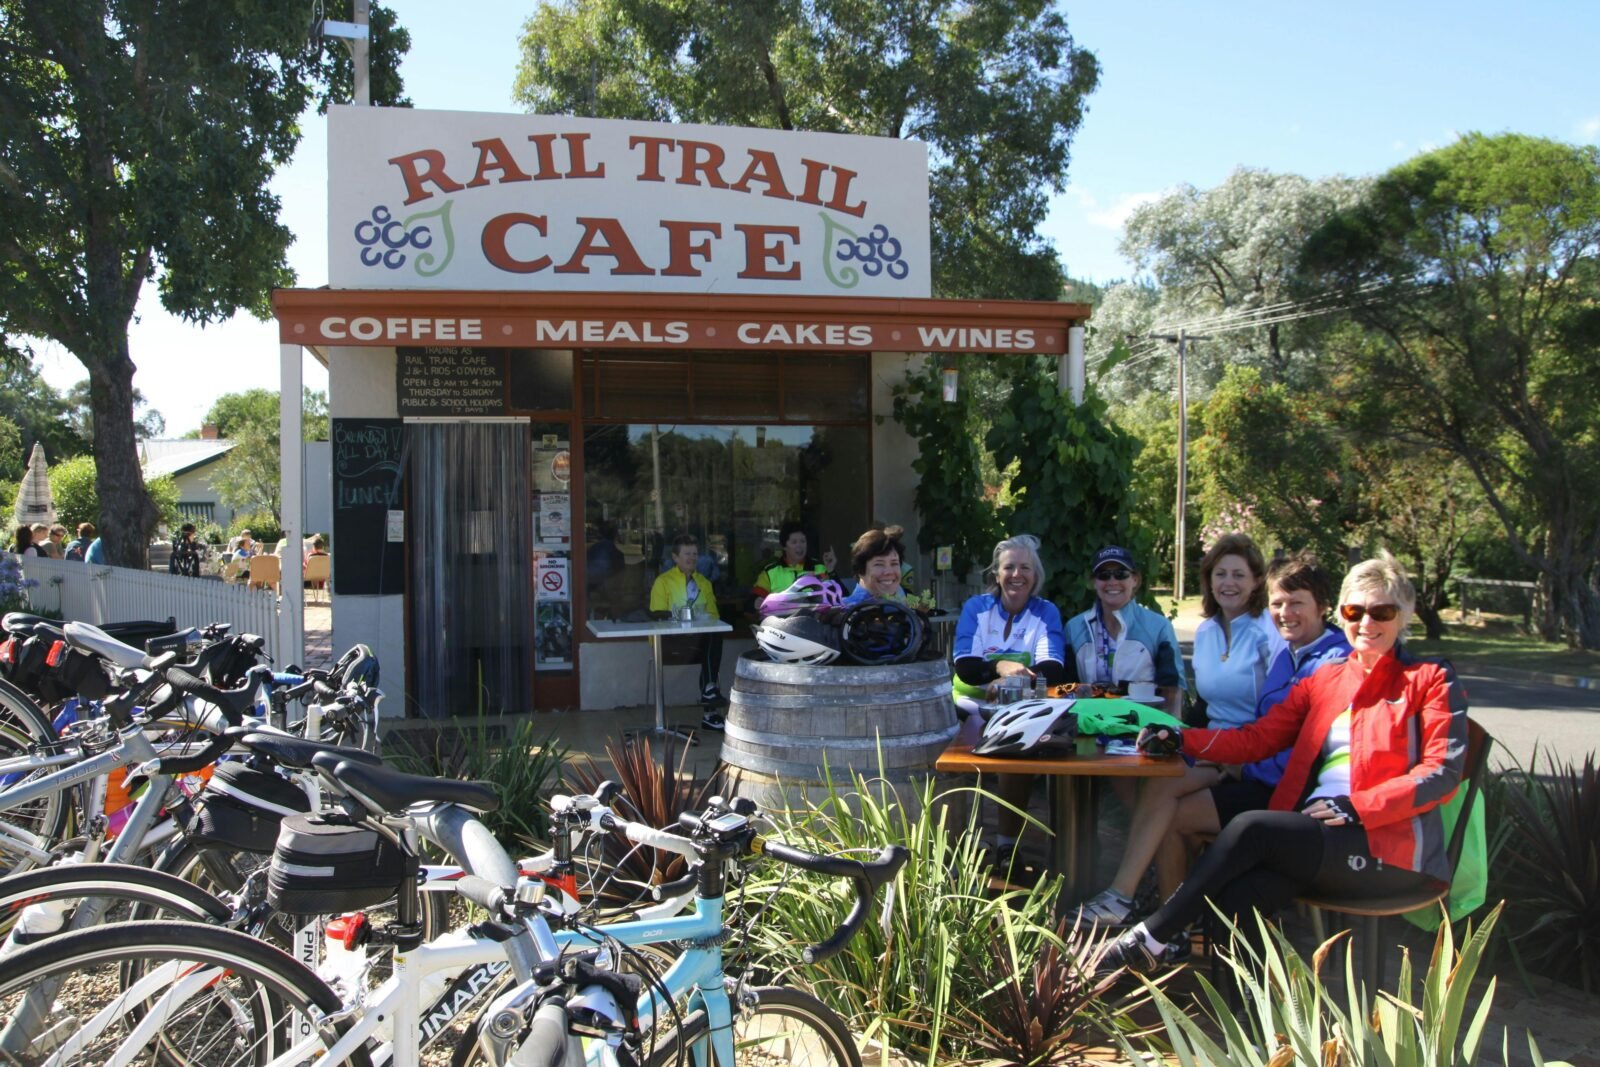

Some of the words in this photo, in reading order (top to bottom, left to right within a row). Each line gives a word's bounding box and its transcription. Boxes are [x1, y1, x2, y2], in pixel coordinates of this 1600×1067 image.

[388, 132, 606, 206] RAIL
[629, 135, 867, 218] TRAIL
[480, 212, 801, 281] CAFE
[319, 316, 483, 340] COFFEE
[536, 319, 689, 343] MEALS
[737, 322, 873, 346] CAKES
[918, 326, 1036, 349] WINES
[405, 356, 424, 365] RAIL
[429, 356, 456, 365] TRAIL
[462, 356, 487, 365] CAFE
[402, 398, 428, 407] PUBLIC
[429, 398, 439, 407] &
[441, 398, 469, 407] SCHOOL
[470, 398, 503, 407] HOLIDAYS
[409, 388, 452, 396] THURSDAY
[462, 388, 495, 396] SUNDAY
